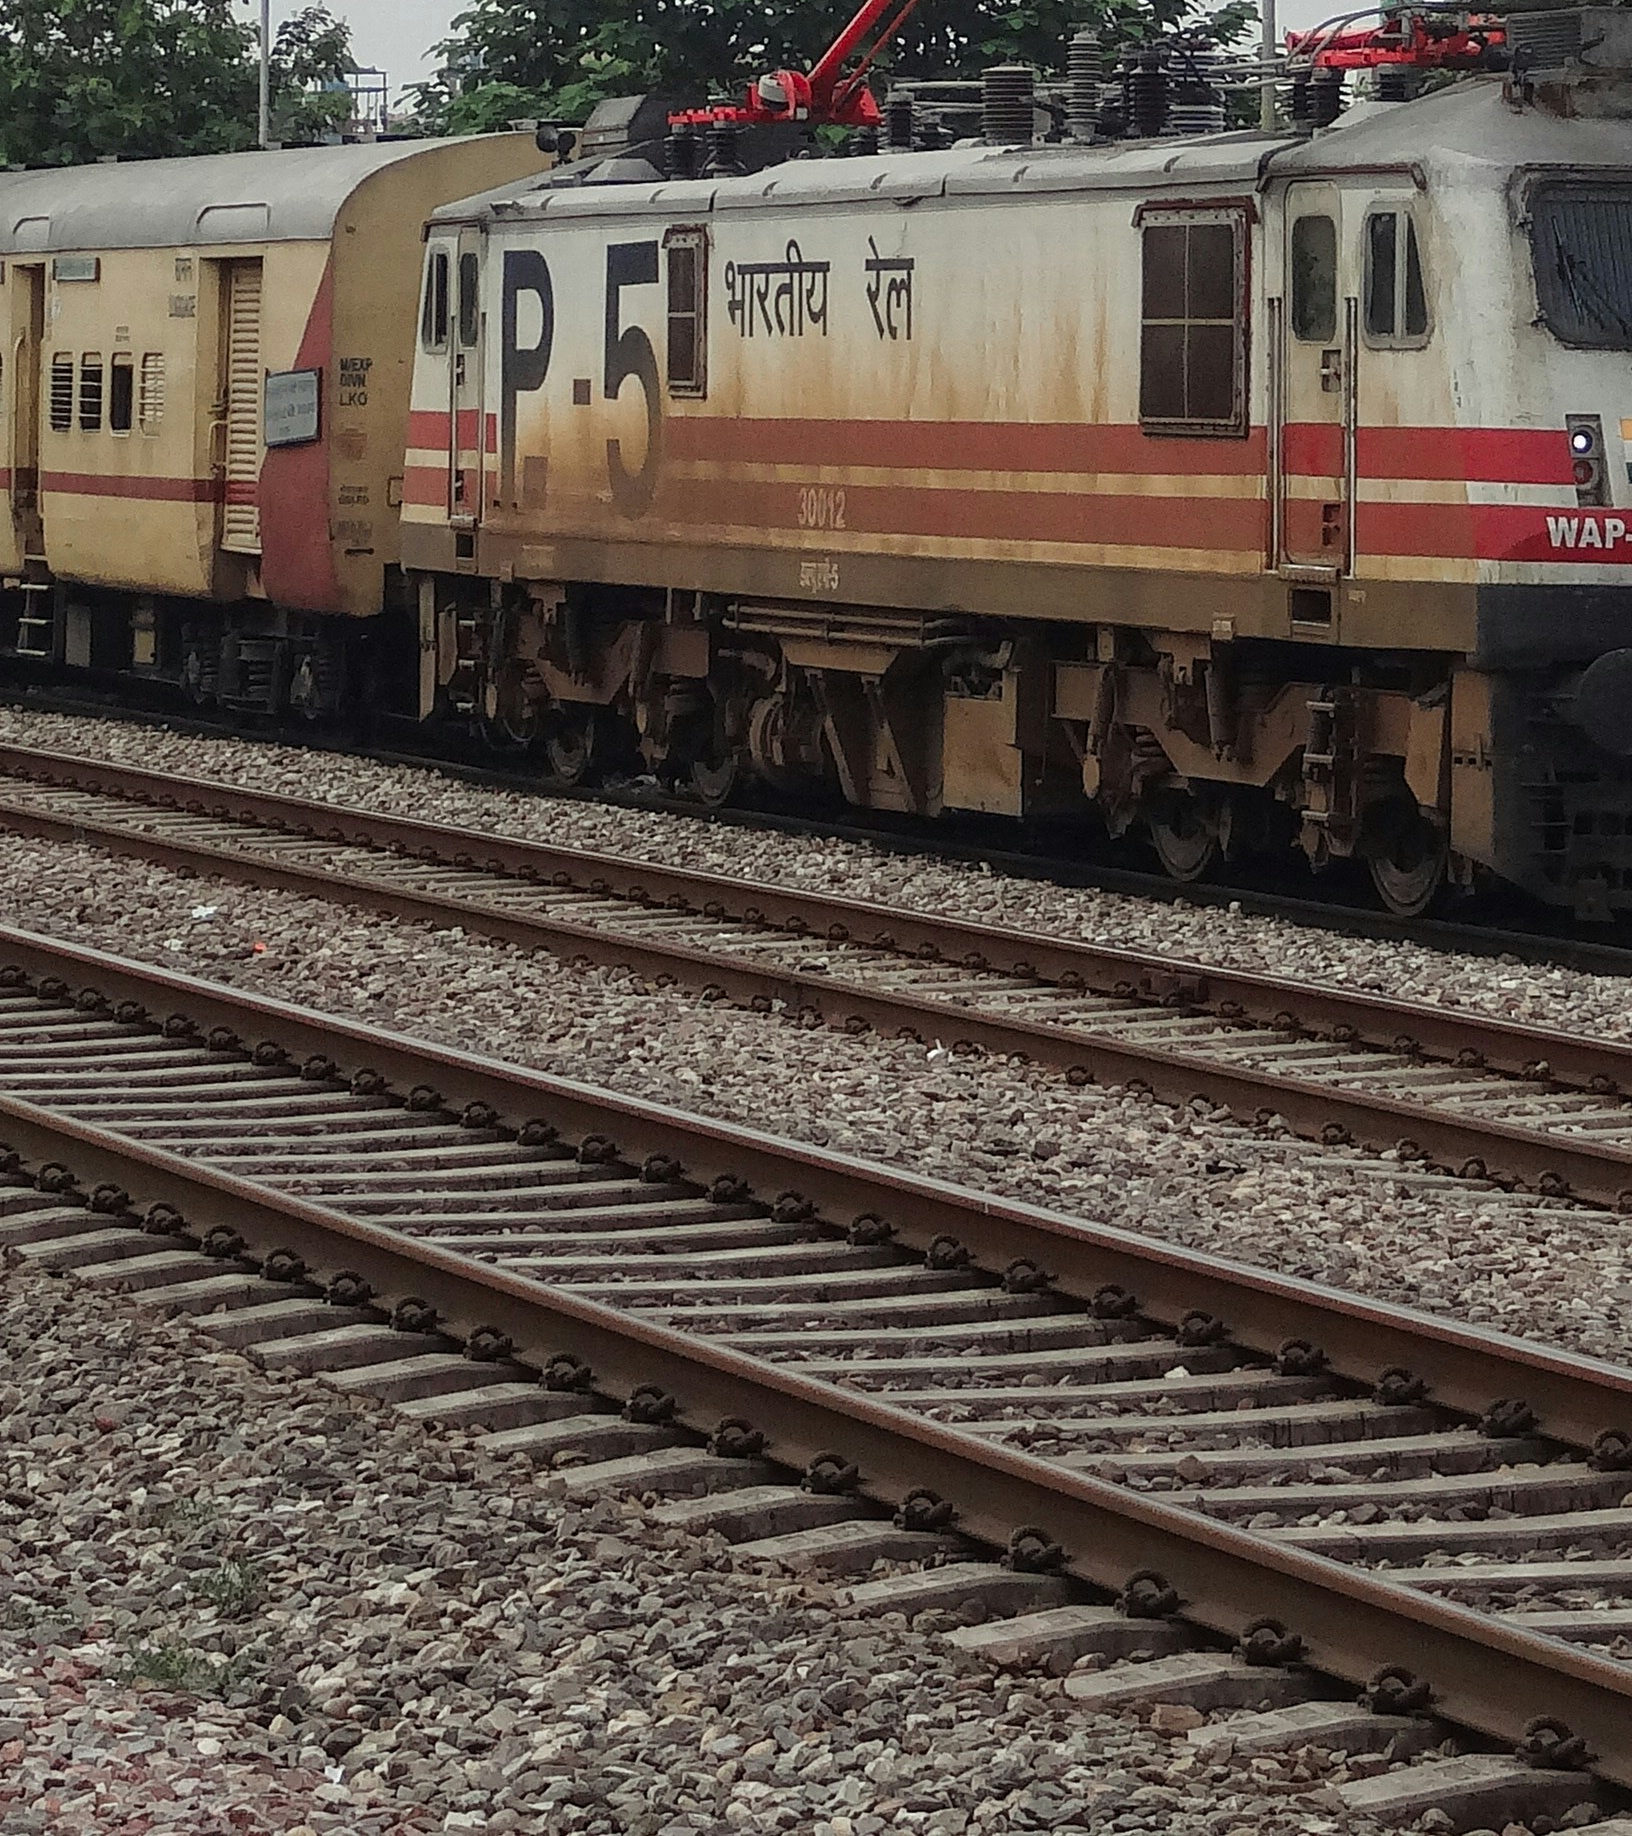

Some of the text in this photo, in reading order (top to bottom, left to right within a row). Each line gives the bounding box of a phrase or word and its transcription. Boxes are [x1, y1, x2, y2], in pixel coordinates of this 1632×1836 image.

[725, 235, 914, 340] भारतीय रेल
[797, 487, 846, 529] 30012
